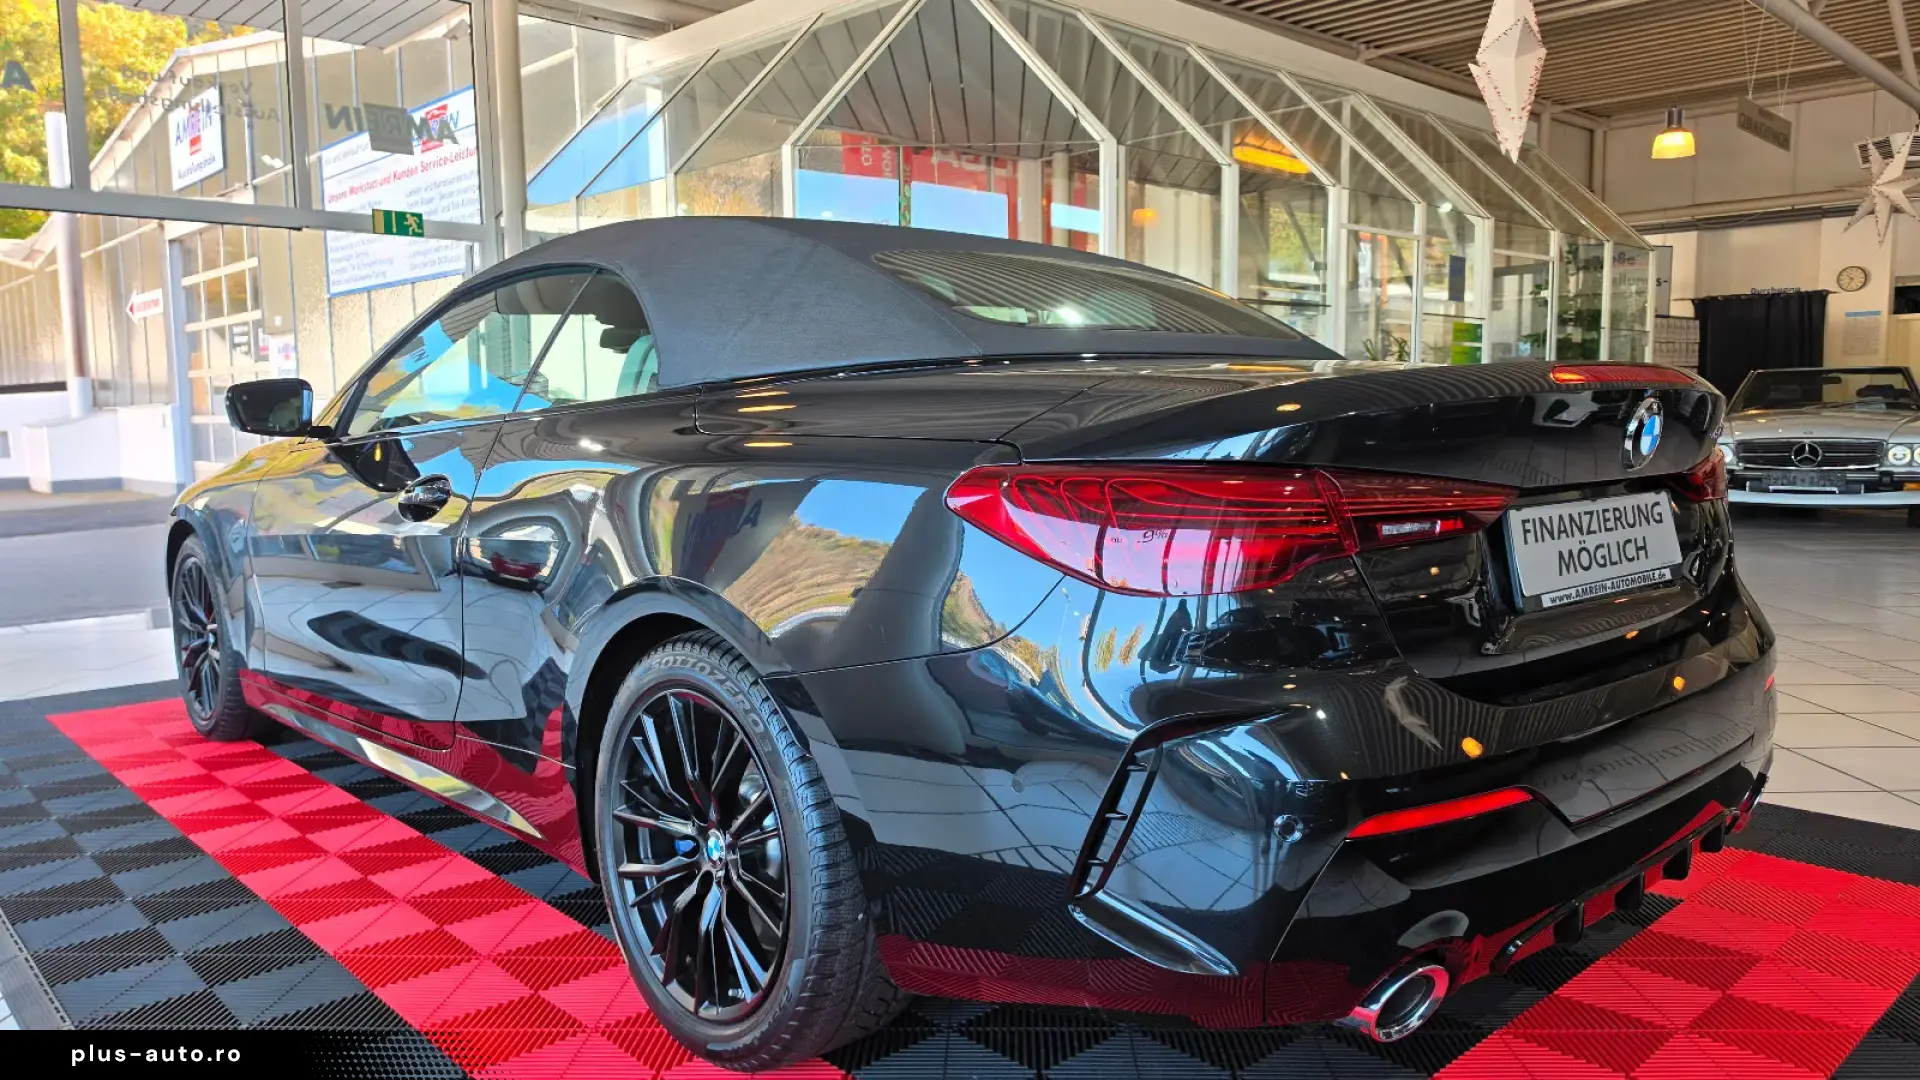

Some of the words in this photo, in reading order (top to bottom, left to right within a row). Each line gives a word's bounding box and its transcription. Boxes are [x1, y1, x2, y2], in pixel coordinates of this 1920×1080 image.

[1521, 501, 1664, 545] FINANZIERUNG
[1558, 536, 1649, 576] MÖGLICH
[1549, 572, 1666, 604] www.AMREIN-AUTOMOBILE.de
